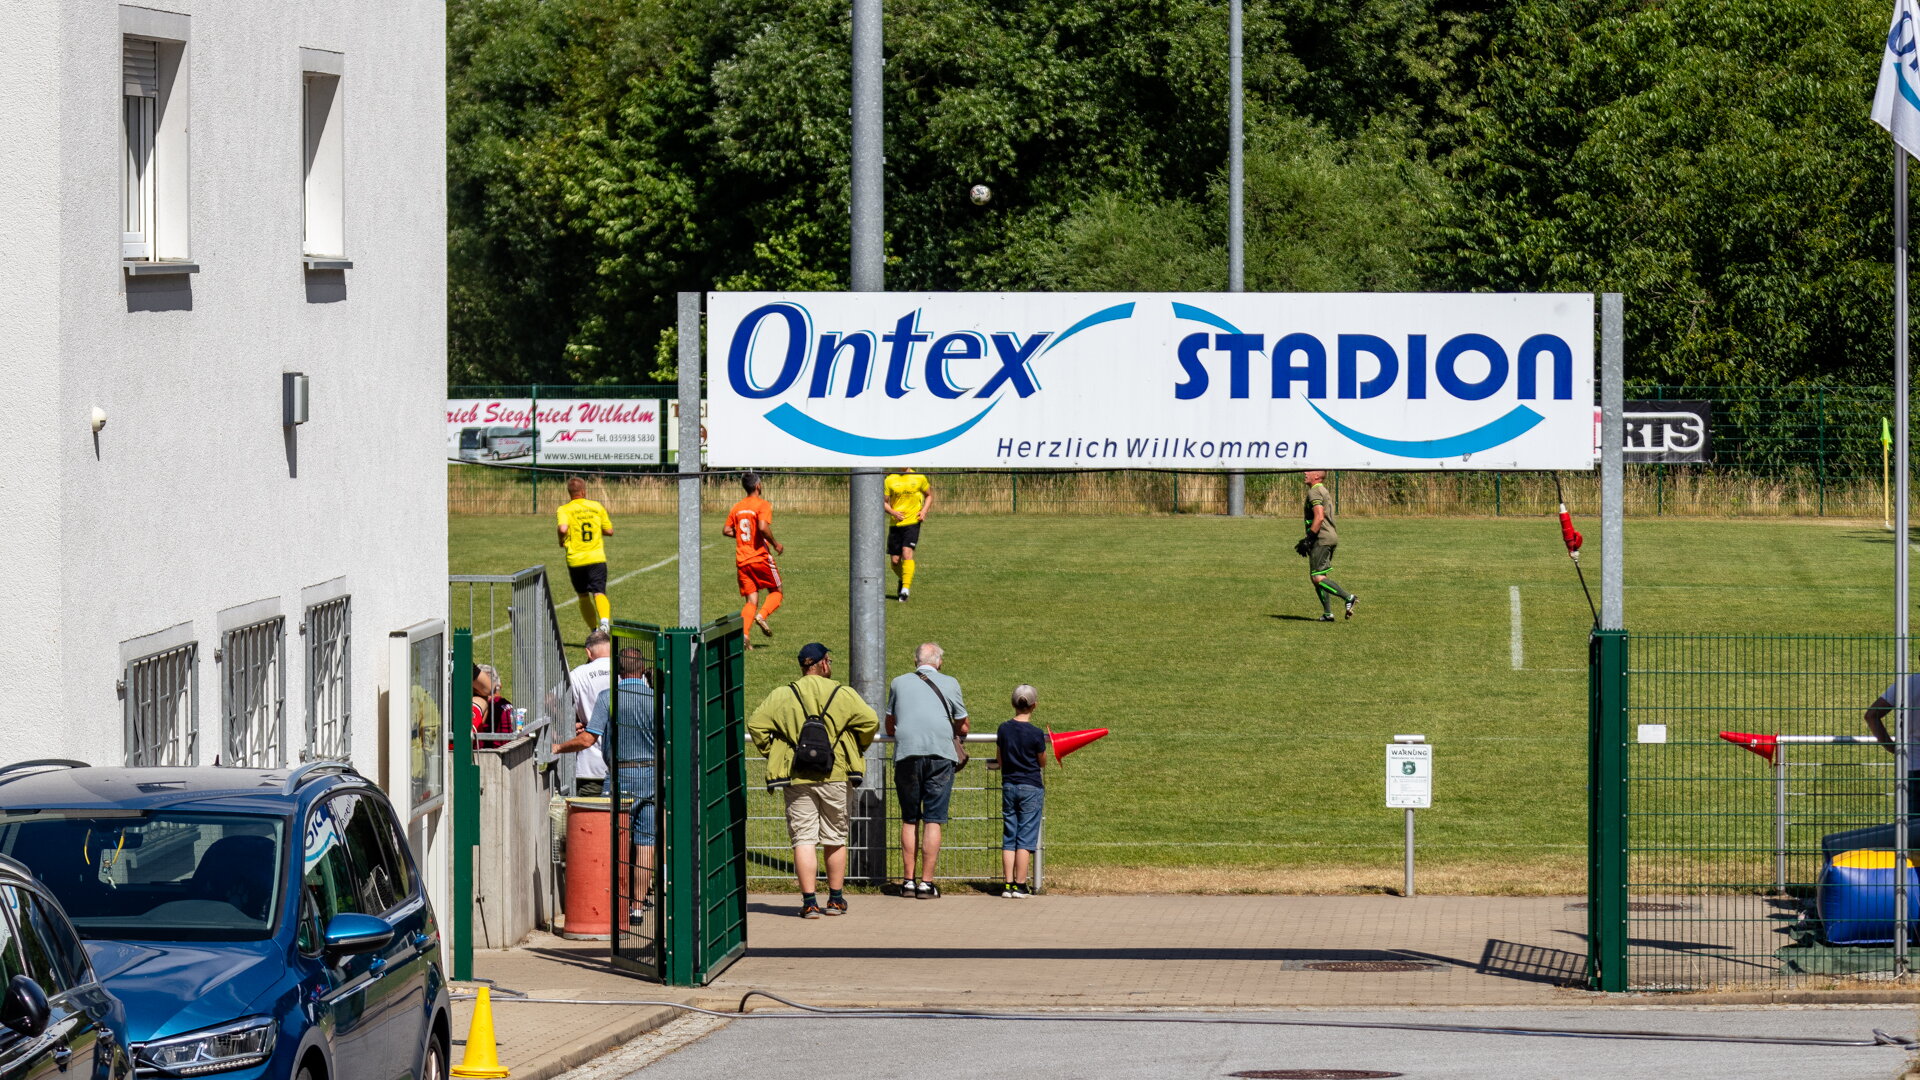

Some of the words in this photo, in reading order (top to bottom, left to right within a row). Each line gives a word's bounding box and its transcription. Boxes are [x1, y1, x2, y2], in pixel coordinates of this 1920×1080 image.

[727, 301, 1054, 400] Ontex
[1174, 332, 1573, 401] STADION
[447, 402, 480, 423] rieb
[483, 401, 574, 430] Siegfried
[577, 401, 654, 423] Wilhelm
[596, 433, 608, 442] Tel.
[609, 433, 636, 442] 035938
[637, 433, 655, 442] 5830
[1622, 421, 1702, 449] RTS
[544, 452, 654, 461] WWW.SWILHELM-REISEN.DE
[996, 437, 1118, 458] Herzlich
[1126, 437, 1308, 459] Willkommen
[581, 522, 593, 543] 6
[739, 518, 751, 542] 9
